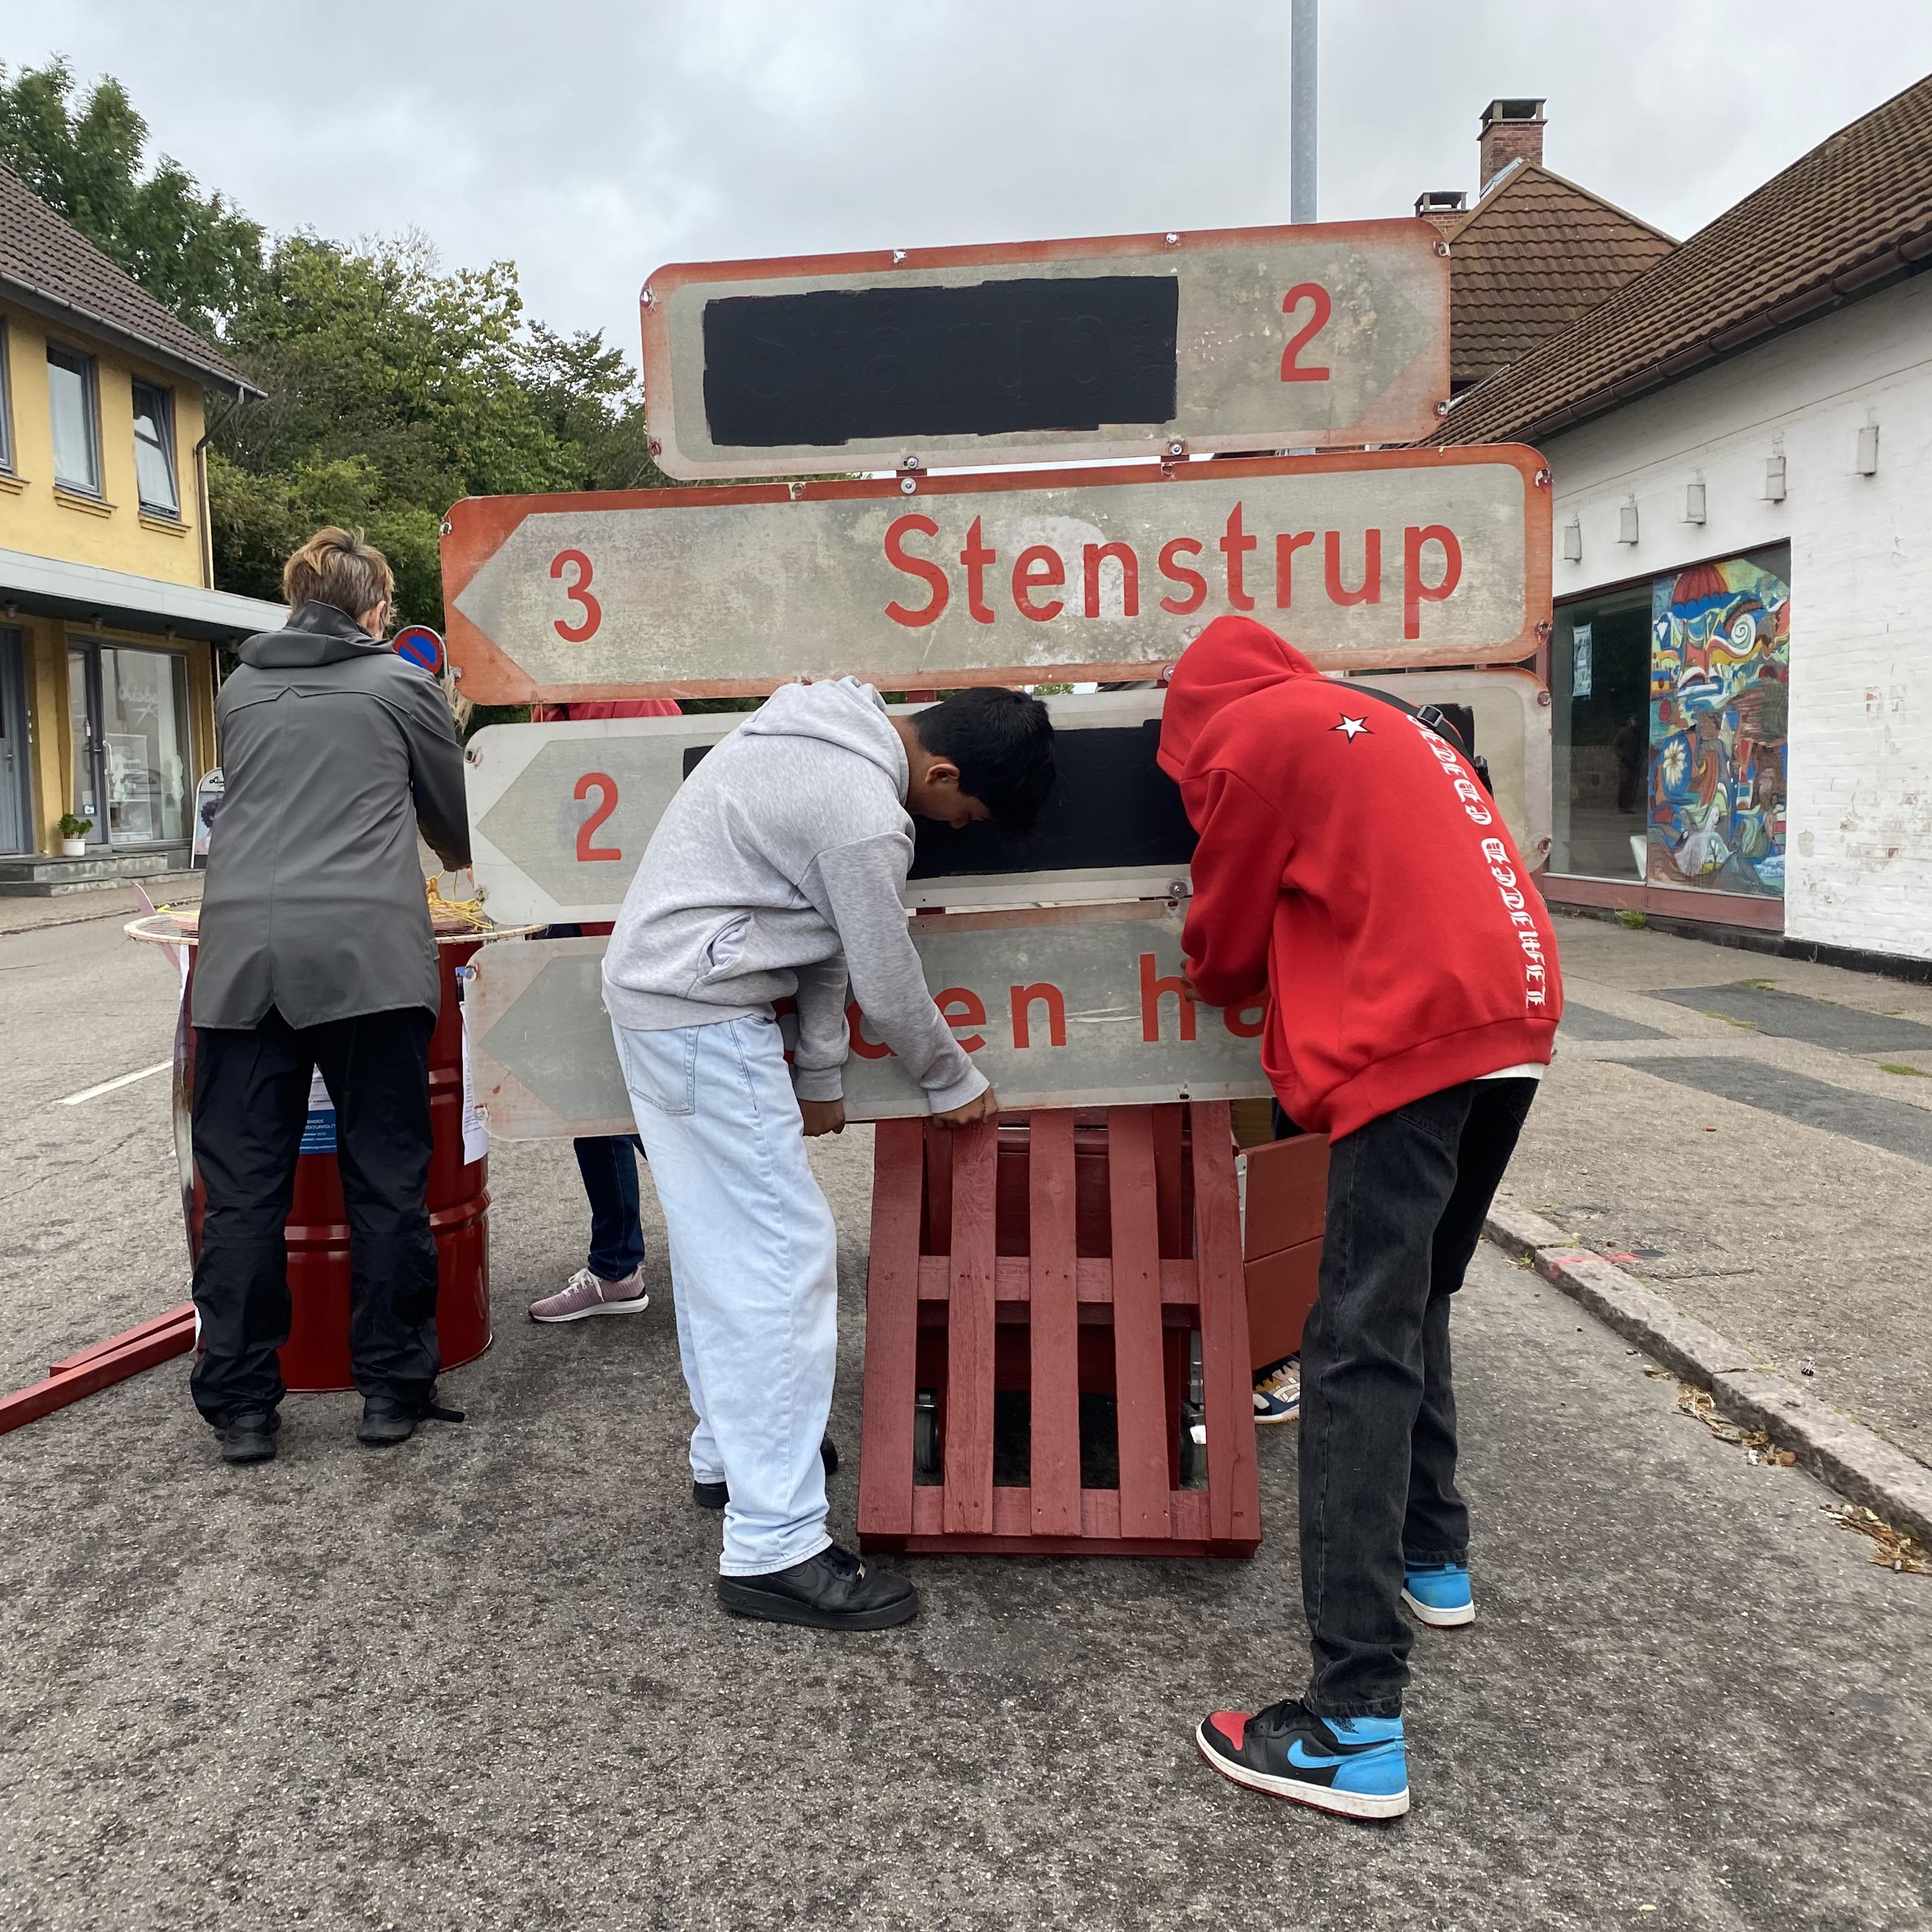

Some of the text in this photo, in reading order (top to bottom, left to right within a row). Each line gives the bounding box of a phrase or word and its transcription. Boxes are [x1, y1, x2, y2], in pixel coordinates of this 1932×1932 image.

[1280, 282, 1332, 383] 2
[550, 500, 1463, 643] 3 Stenstrup
[573, 771, 622, 862] 2
[1481, 837, 1547, 1010] LIMITED
